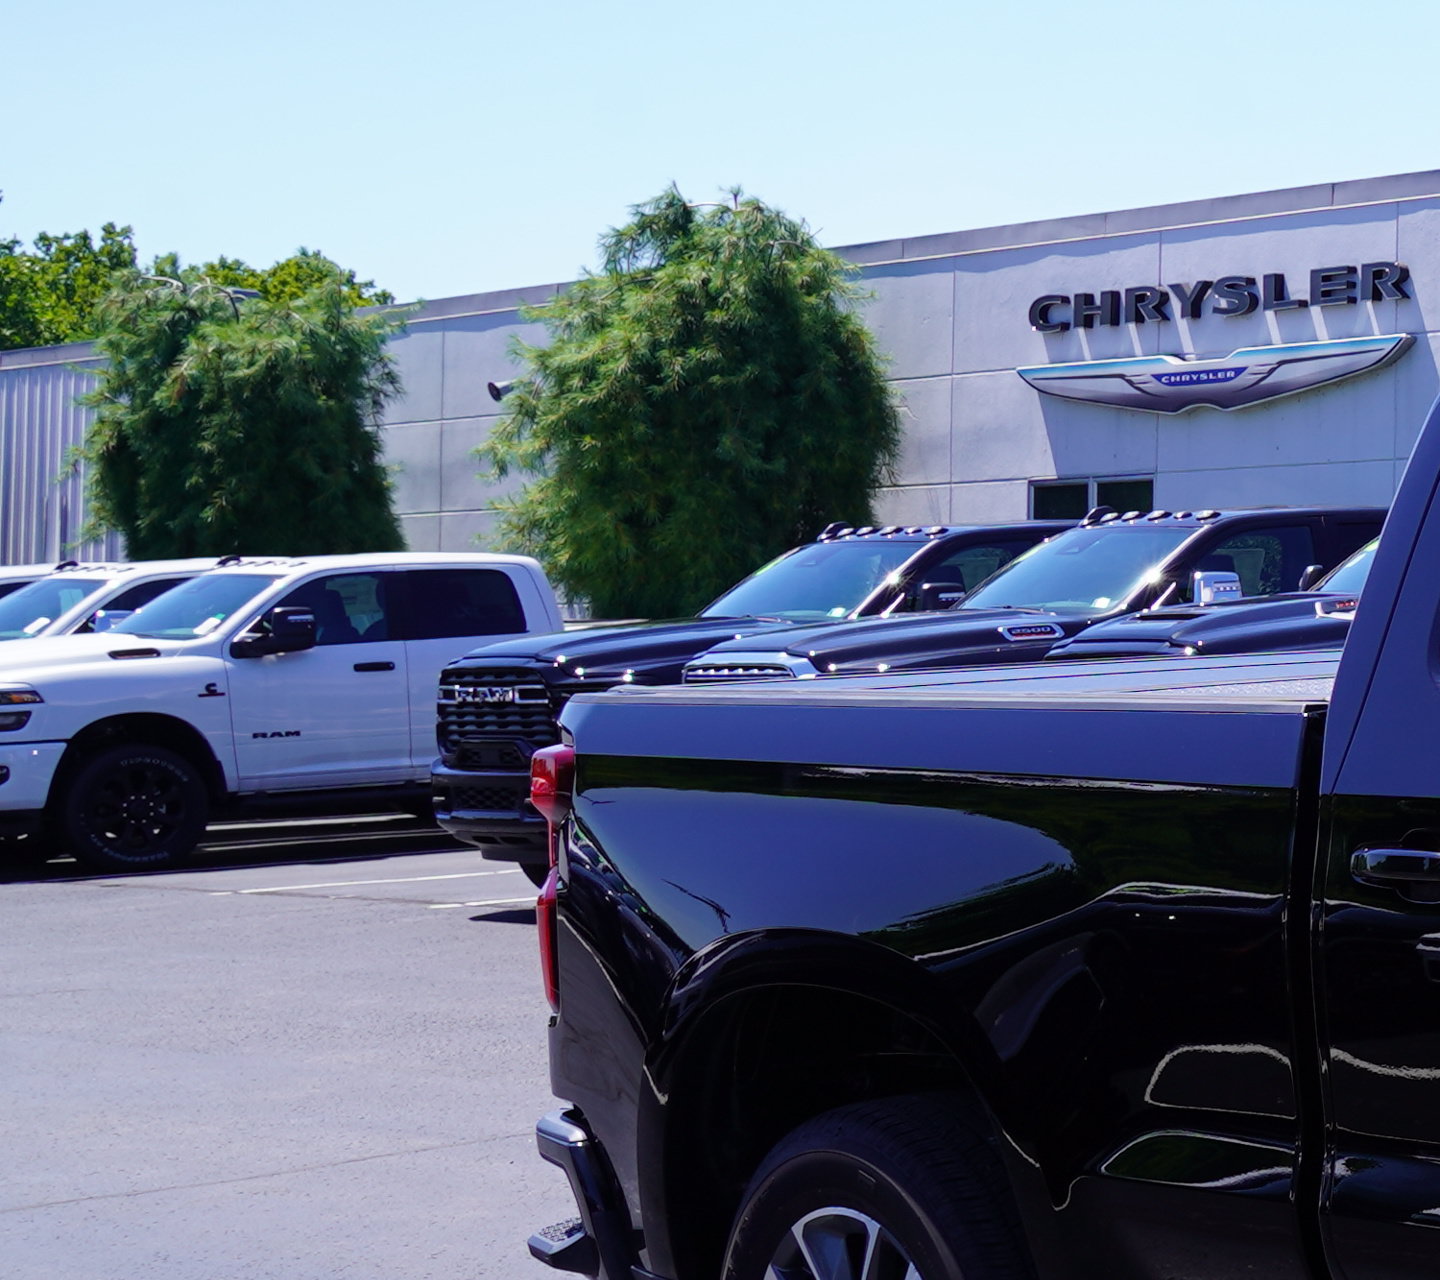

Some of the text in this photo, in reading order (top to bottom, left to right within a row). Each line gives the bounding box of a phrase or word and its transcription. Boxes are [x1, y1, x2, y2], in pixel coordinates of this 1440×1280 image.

[1028, 261, 1411, 333] CHRYSLER
[1161, 370, 1236, 384] CHRYSLER
[455, 685, 514, 702] RAM
[252, 730, 301, 739] RAM
